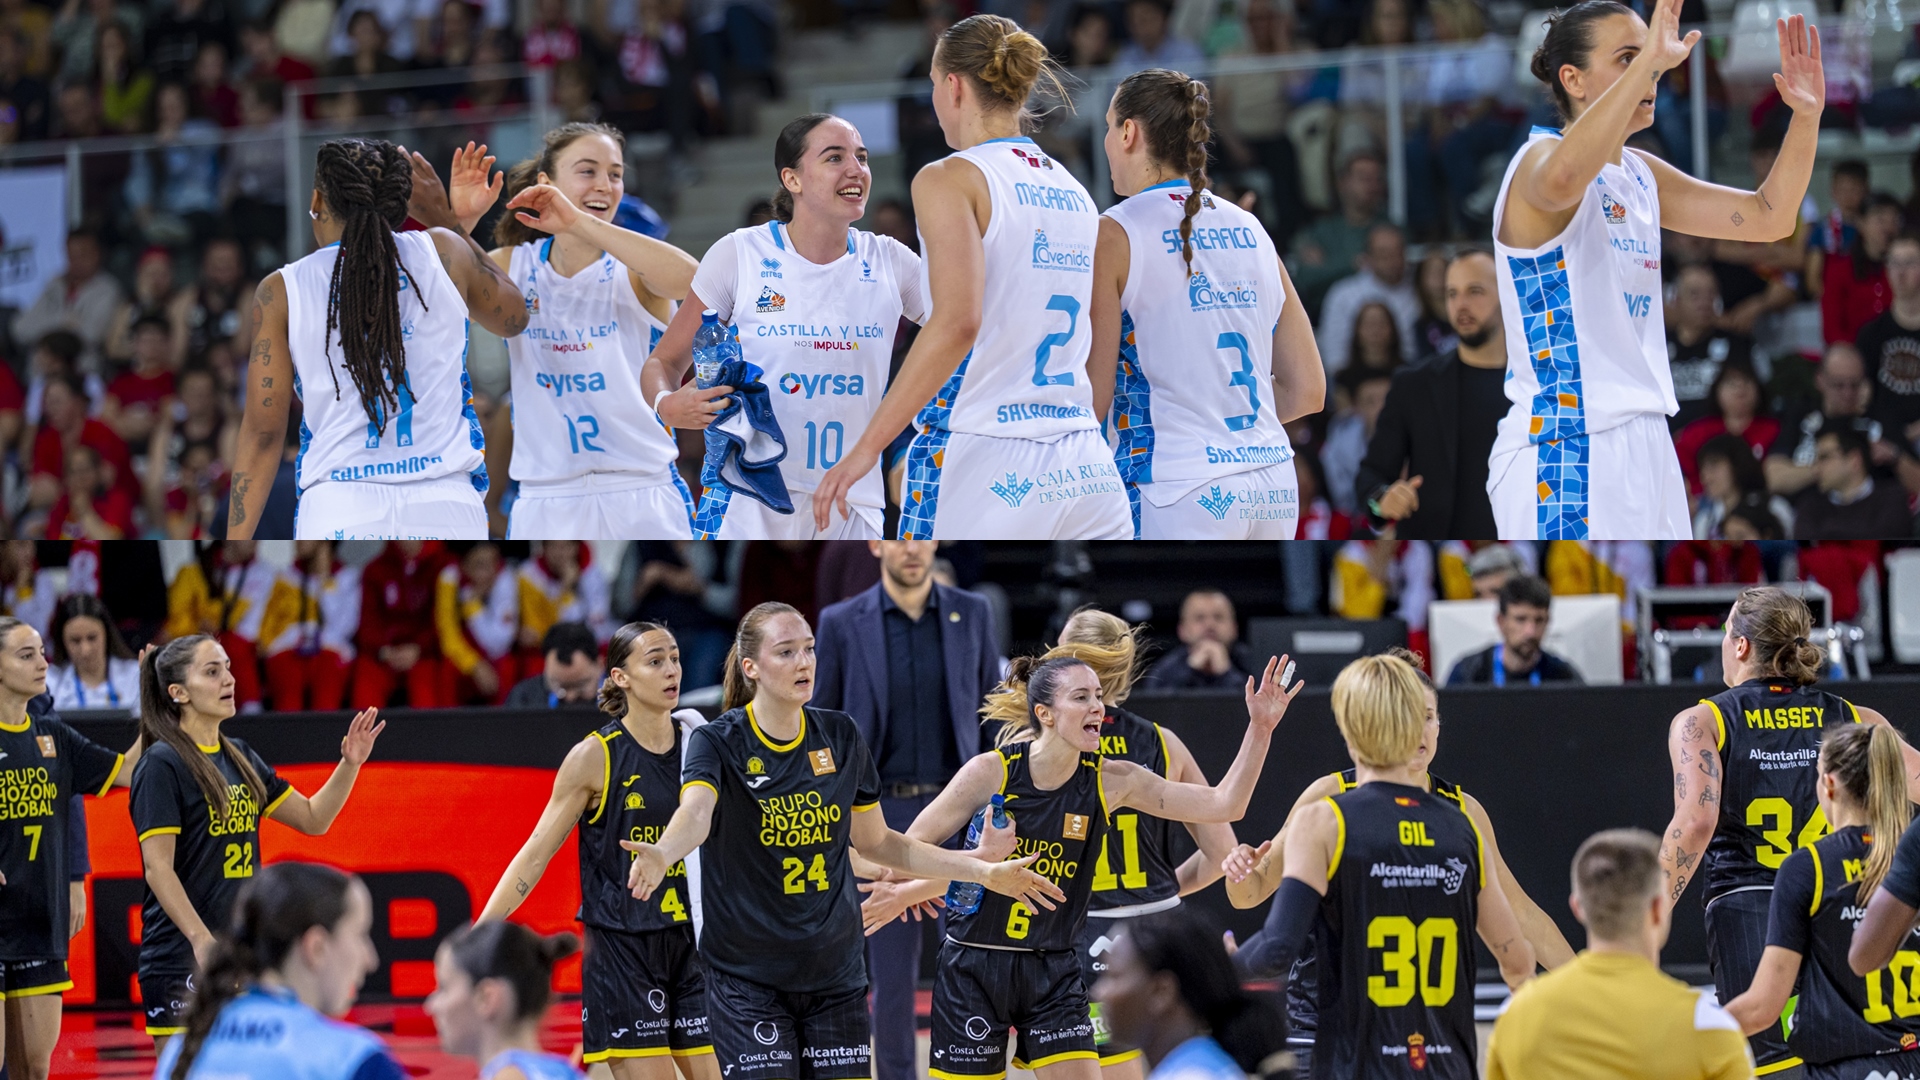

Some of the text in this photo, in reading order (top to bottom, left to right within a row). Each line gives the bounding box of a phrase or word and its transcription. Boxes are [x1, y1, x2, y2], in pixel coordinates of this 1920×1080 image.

[1015, 182, 1089, 213] MAGARITY
[756, 305, 786, 313] AVENIDA
[757, 322, 884, 339] CASTILLA Y LEÓN
[1032, 294, 1081, 387] 2
[552, 341, 594, 354] IMPULSA
[794, 340, 859, 352] NOS IMPULSA
[1216, 331, 1261, 433] 3
[563, 414, 606, 454] 12
[804, 421, 844, 470] 10
[1036, 463, 1118, 489] CAJA RURAL
[1039, 481, 1122, 504] DE SALAMANCA
[1238, 489, 1266, 508] CAJA
[1744, 706, 1824, 730] MASSEY
[1749, 748, 1817, 761] Alcantarilla
[0, 767, 48, 788] GRUPO
[0, 800, 54, 821] GLOBAL
[758, 790, 822, 816] GRUPO
[209, 816, 256, 837] GLOBAL
[761, 804, 841, 831] HOZONO
[23, 825, 43, 861] 7
[760, 825, 832, 848] GLOBAL
[1398, 820, 1436, 847] GIL
[1015, 836, 1064, 859] RUPO
[223, 842, 253, 879] 22
[1369, 862, 1447, 879] Alcantarilla
[782, 853, 830, 895] 24
[660, 887, 688, 922] 4
[1005, 901, 1033, 940] 6
[1367, 915, 1458, 1007] 30
[1863, 950, 1920, 1024] 10
[635, 1019, 661, 1030] Costa
[738, 1053, 769, 1064] Costa
[949, 1044, 975, 1055] Costa
